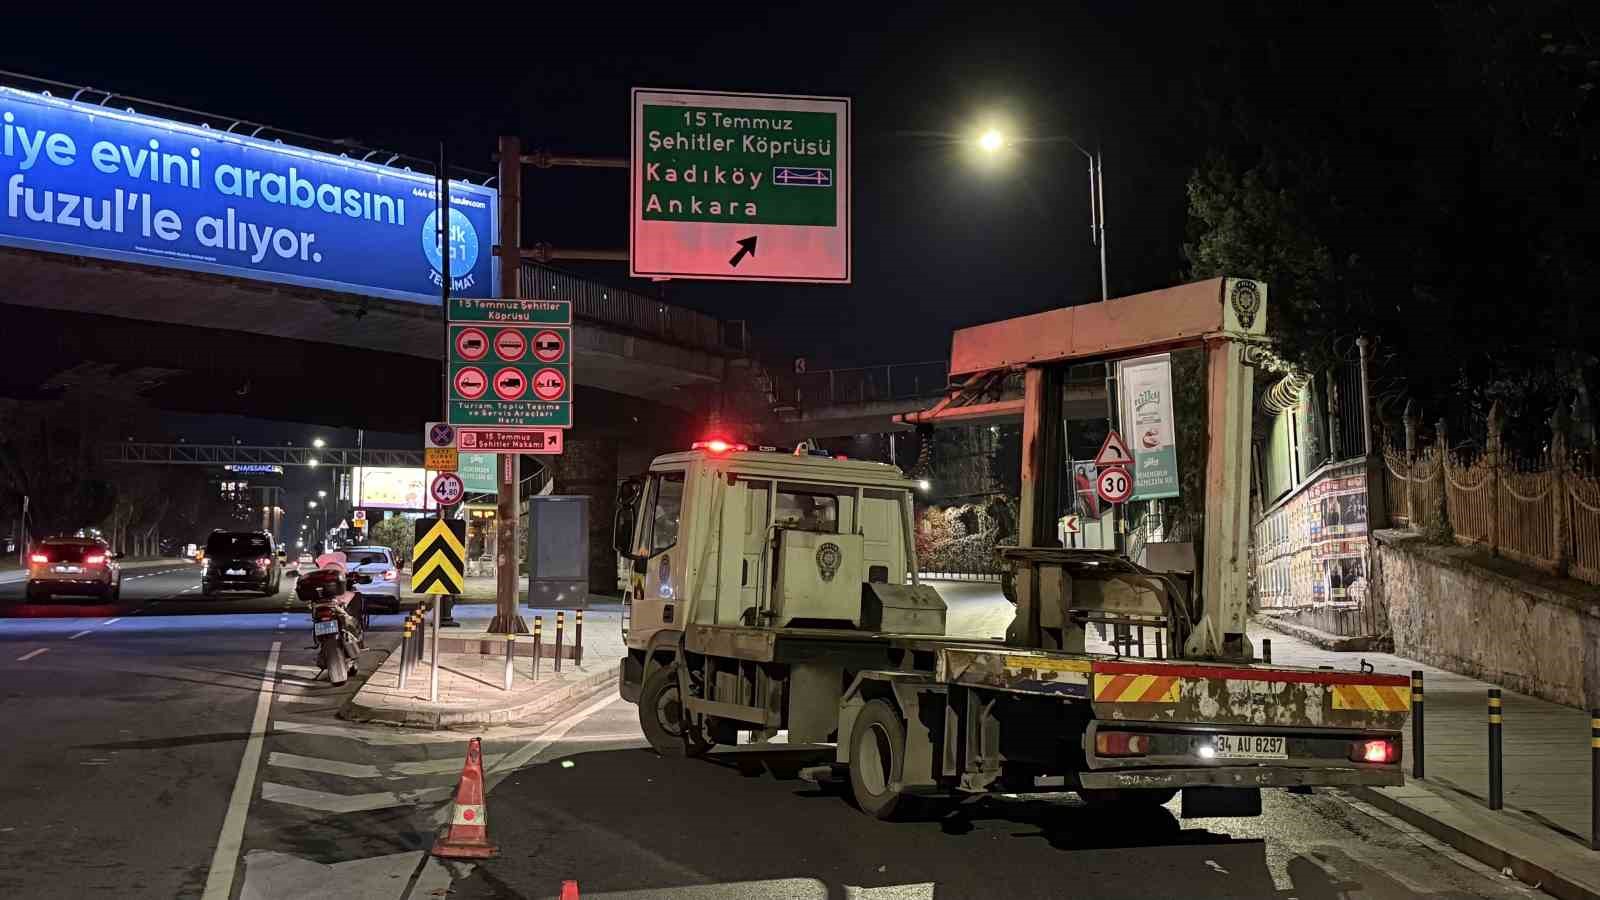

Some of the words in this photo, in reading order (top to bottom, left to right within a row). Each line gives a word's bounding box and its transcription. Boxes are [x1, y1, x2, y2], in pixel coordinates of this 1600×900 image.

[683, 111, 707, 127] 15
[712, 112, 793, 130] Temmuz
[648, 130, 735, 152] Şehitler
[742, 134, 832, 158] Köprüsü
[0, 112, 77, 170] iye
[91, 139, 200, 189] evini
[214, 163, 405, 225] arabasını
[646, 162, 763, 190] Kadıköy
[646, 193, 757, 216] Ankara
[8, 173, 182, 240] fuzul'le
[195, 207, 323, 264] alıyor.
[475, 301, 518, 310] Temmuz
[521, 301, 560, 311] Şehitler
[488, 311, 530, 321] Köprüsü
[497, 433, 531, 441] Temmuz
[1105, 477, 1127, 493] 30
[1218, 736, 1231, 752] 34
[1237, 737, 1251, 752] AU
[1255, 737, 1283, 753] 8297
